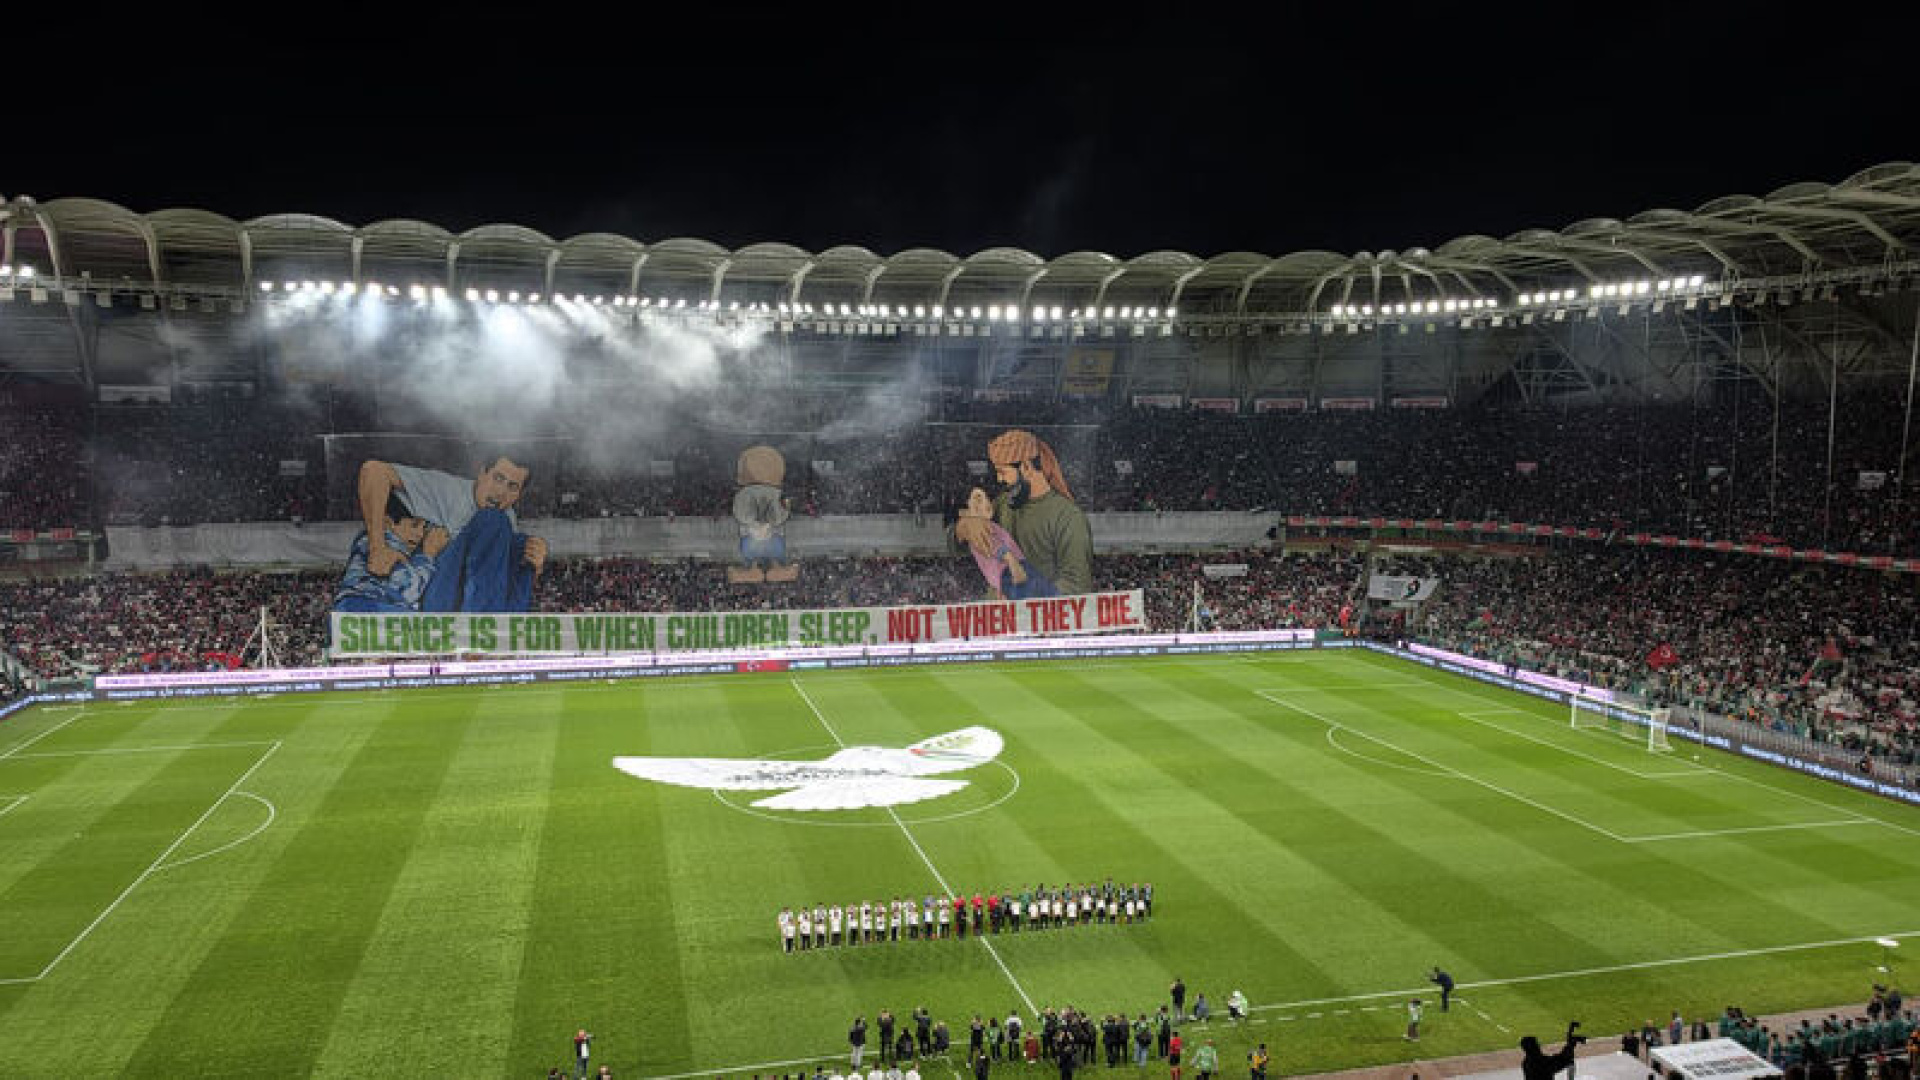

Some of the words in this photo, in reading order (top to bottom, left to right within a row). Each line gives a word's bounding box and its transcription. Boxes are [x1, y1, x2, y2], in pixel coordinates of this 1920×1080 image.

[340, 616, 457, 652] SILENCE
[470, 616, 497, 651] IS
[509, 616, 561, 650] FOR
[573, 616, 656, 650] WHEN
[667, 614, 788, 648] CHILDREN
[887, 609, 937, 643] NOT
[947, 604, 1017, 637] WHEN
[1026, 598, 1086, 634] THEY
[1097, 594, 1139, 627] DIE.
